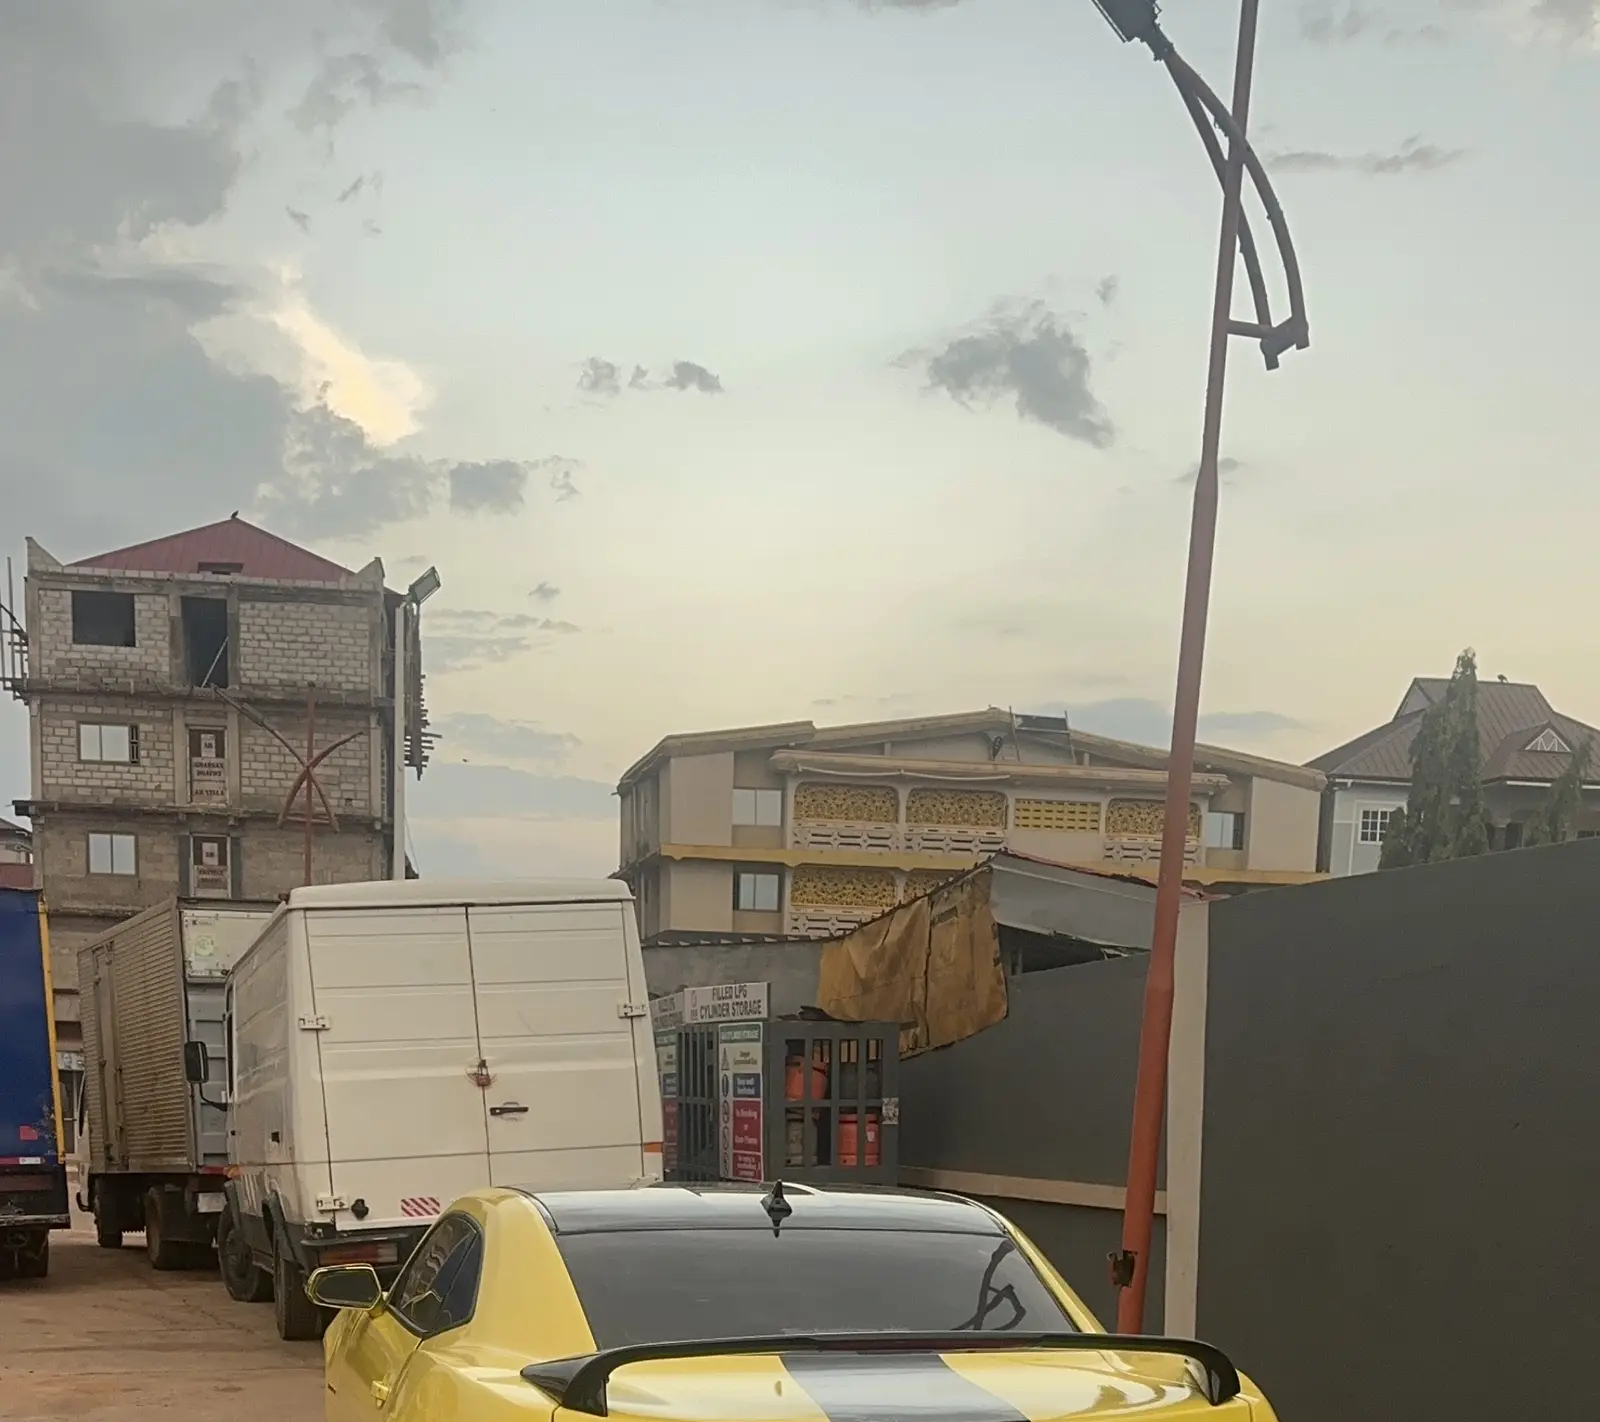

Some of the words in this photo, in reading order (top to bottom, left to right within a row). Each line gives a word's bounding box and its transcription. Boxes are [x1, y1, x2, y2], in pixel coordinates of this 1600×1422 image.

[712, 986, 733, 1001] FILLED
[700, 1002, 730, 1019] CYLINDER
[732, 999, 762, 1017] STORAGE
